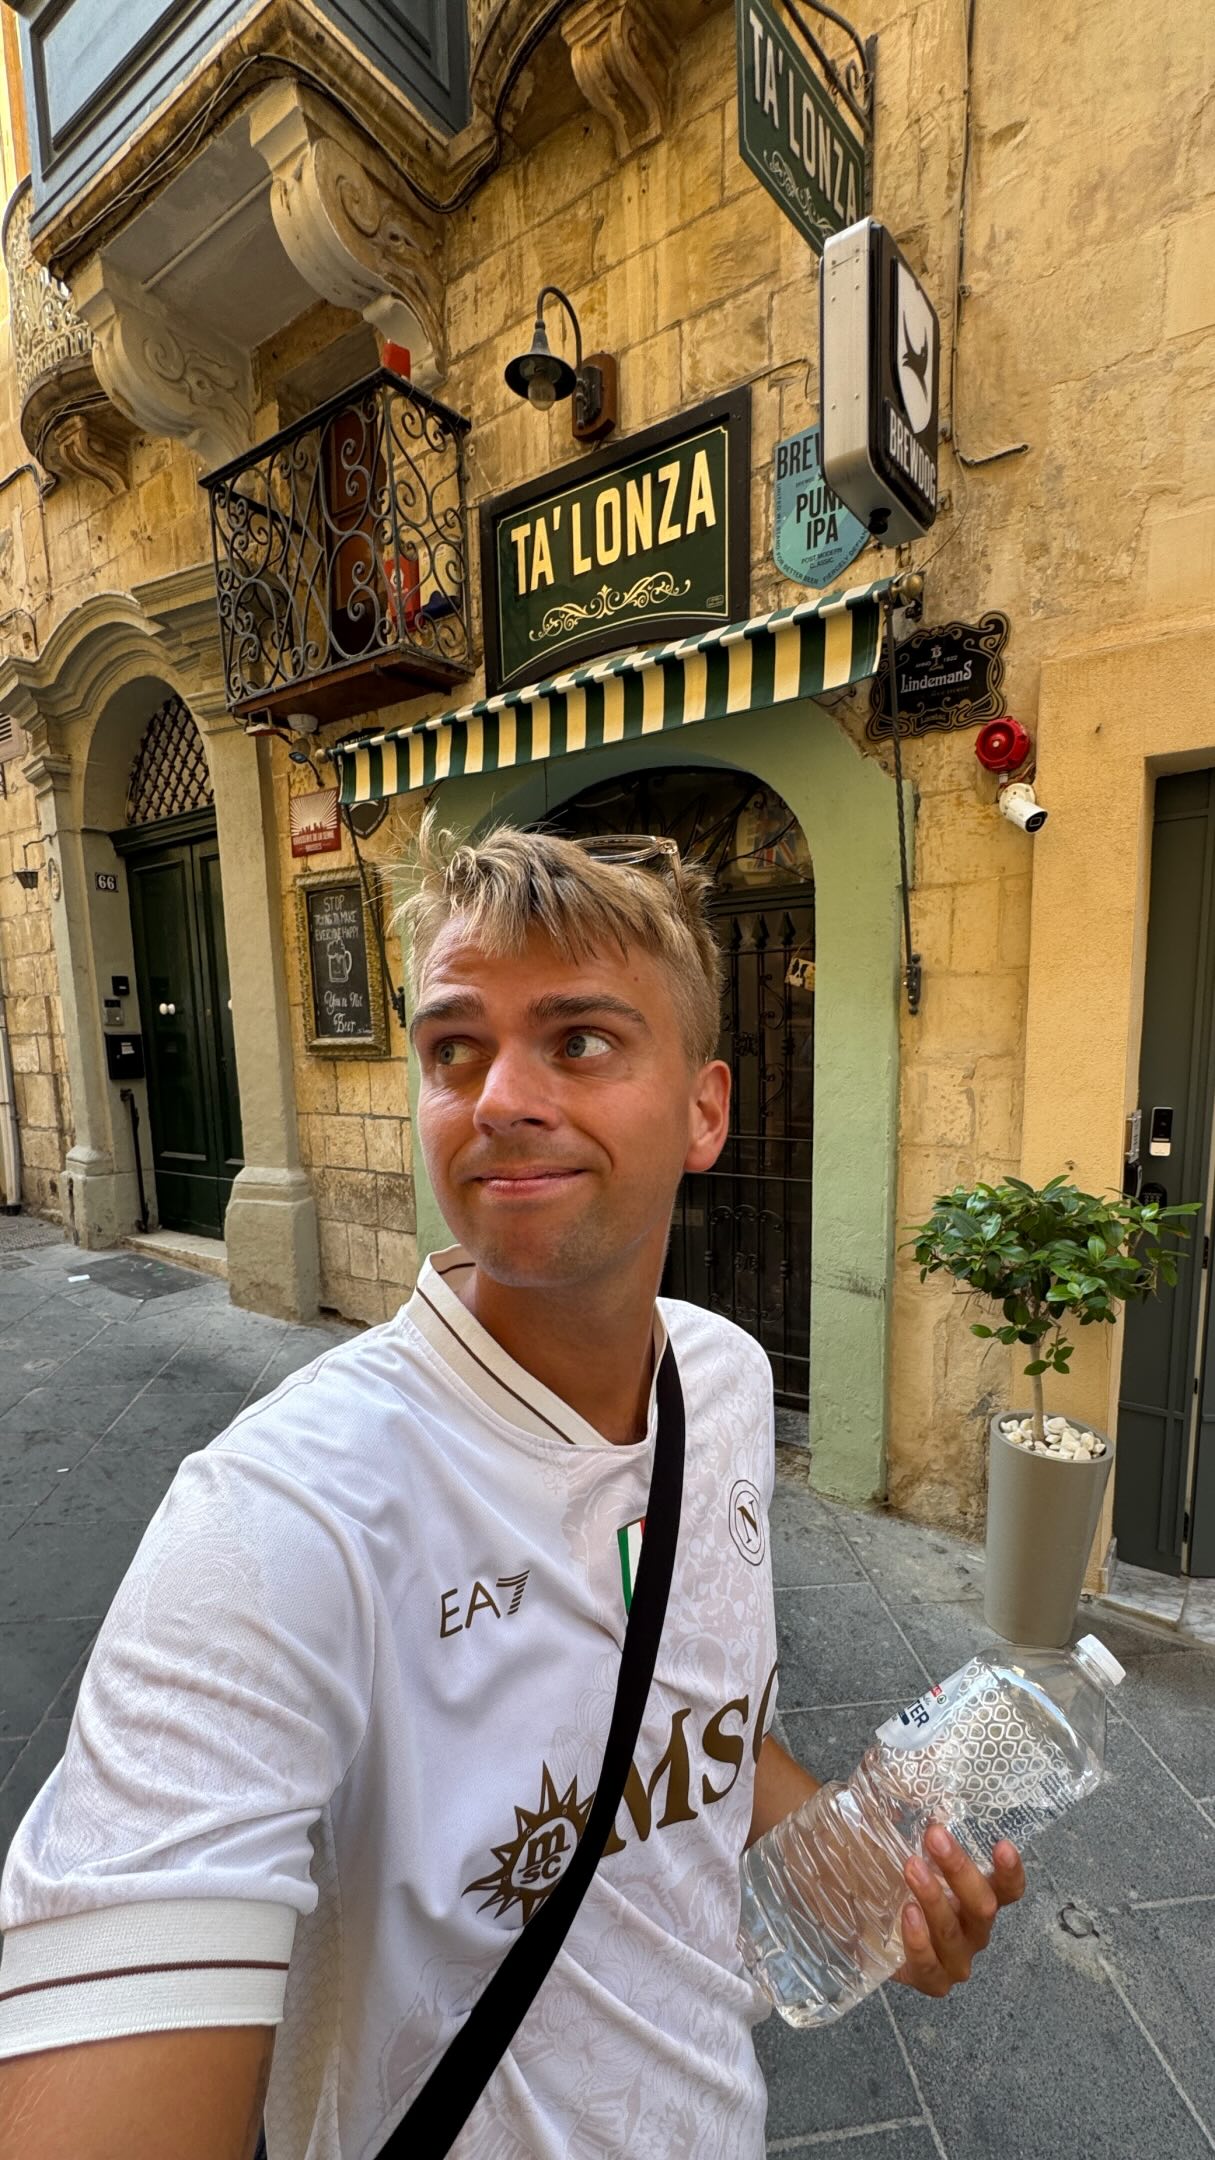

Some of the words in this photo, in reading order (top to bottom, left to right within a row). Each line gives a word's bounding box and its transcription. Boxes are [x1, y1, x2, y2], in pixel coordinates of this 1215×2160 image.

[889, 408, 936, 506] BREWDOG
[806, 513, 839, 551] IPA
[801, 554, 816, 565] POST
[817, 547, 843, 559] MODERN
[810, 556, 835, 569] CLASSIC
[776, 551, 785, 566] FOR
[783, 565, 803, 580] BETTER
[803, 575, 819, 585] BEER
[822, 556, 849, 582] FIERCELY
[98, 875, 115, 890] 66
[323, 894, 345, 913] STOP
[340, 909, 357, 924] MAKE
[342, 925, 359, 939] HAPPY
[333, 1012, 356, 1034] Beer
[439, 1569, 530, 1639] EA7
